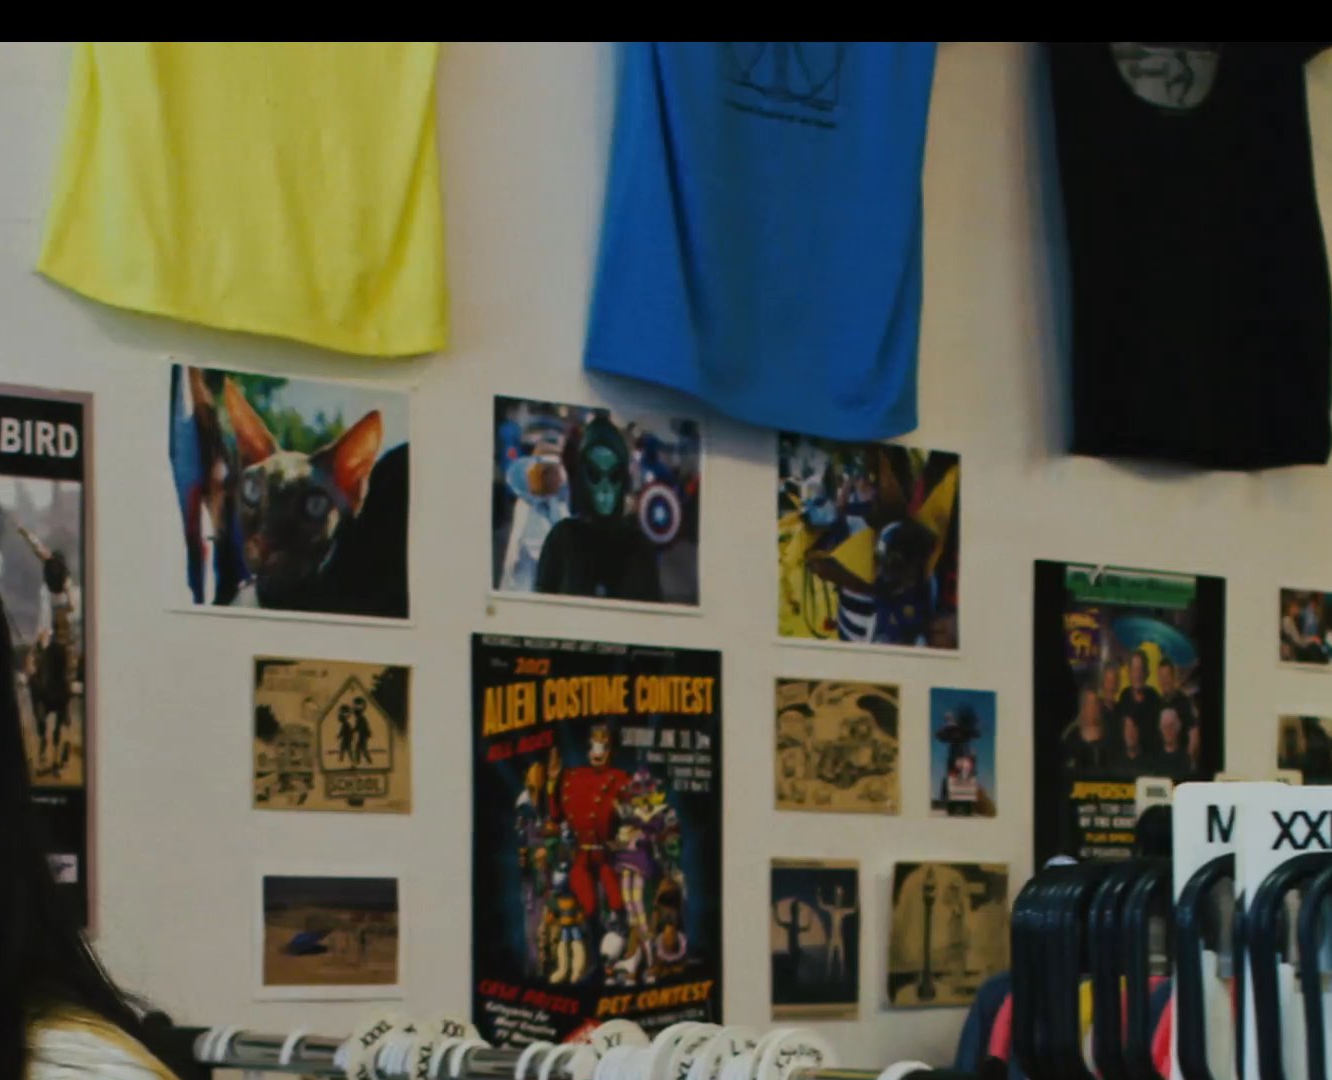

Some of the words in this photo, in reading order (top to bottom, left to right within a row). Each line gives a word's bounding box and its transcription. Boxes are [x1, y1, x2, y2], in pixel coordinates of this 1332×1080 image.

[0, 416, 79, 459] BIRD
[482, 680, 538, 737] ALIEN
[542, 673, 630, 723] COSTUME
[634, 674, 715, 716] CONTEST
[597, 994, 631, 1018] PET
[636, 979, 715, 1010] CONTEST
[417, 1042, 434, 1080] XXL
